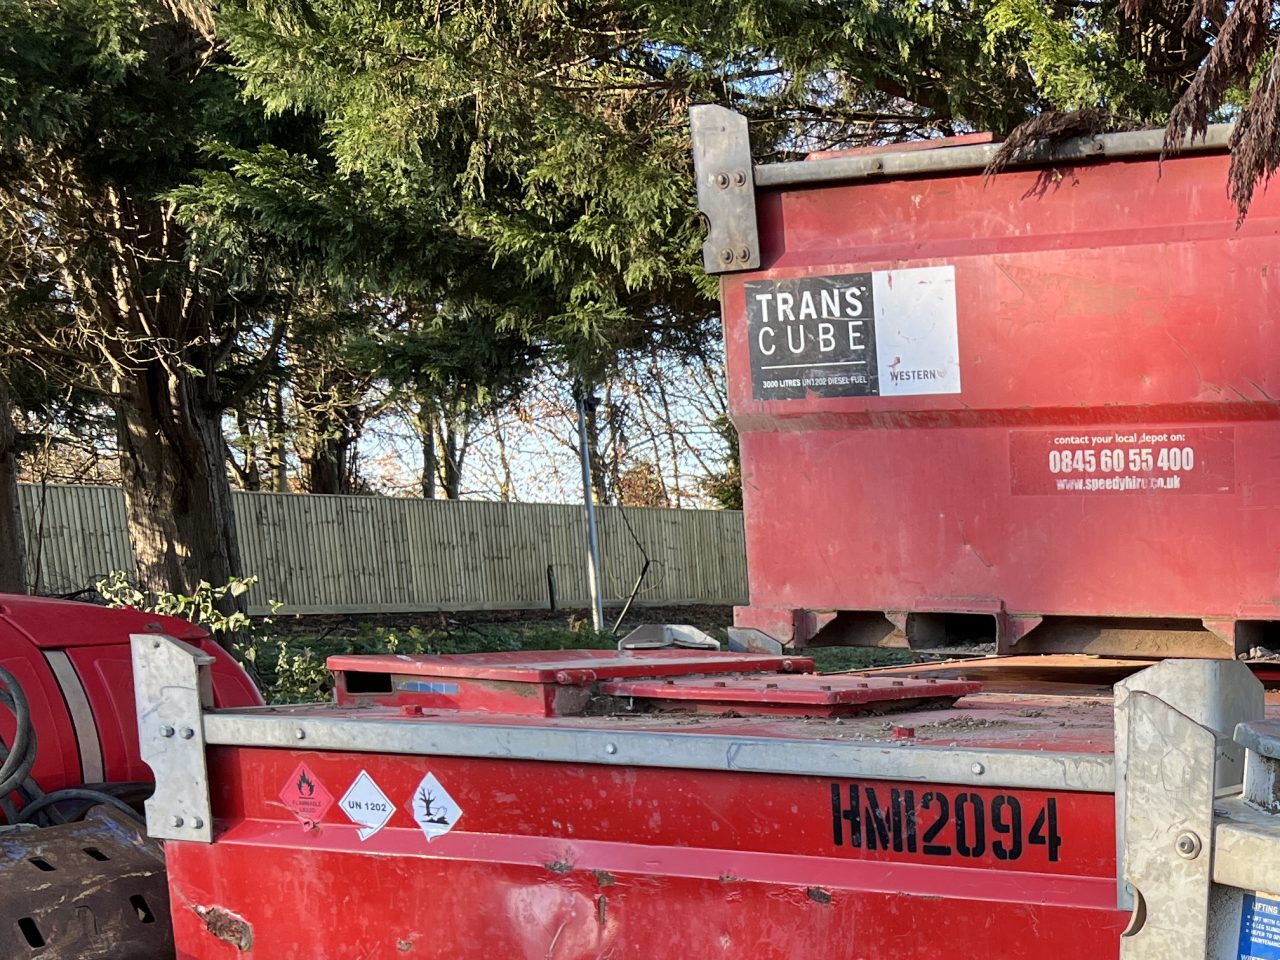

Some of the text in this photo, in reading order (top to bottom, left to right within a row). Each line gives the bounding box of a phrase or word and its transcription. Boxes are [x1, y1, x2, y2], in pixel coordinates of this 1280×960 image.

[756, 286, 864, 323] TRANS
[758, 321, 865, 356] CUBE
[762, 375, 868, 389] 3000 LITRES UN1202 DIESEL FUEL
[889, 369, 937, 382] WESTERN
[1054, 435, 1089, 445] contact
[1091, 435, 1113, 446] your
[1115, 433, 1137, 443] local
[1170, 434, 1186, 442] on:
[1049, 447, 1194, 473] 0845 60 55 400
[1056, 475, 1181, 491] www.speedyhireco.uk
[348, 800, 387, 812] UN 1202
[831, 783, 1062, 862] HMI2094
[1252, 902, 1278, 915] LIFTING
